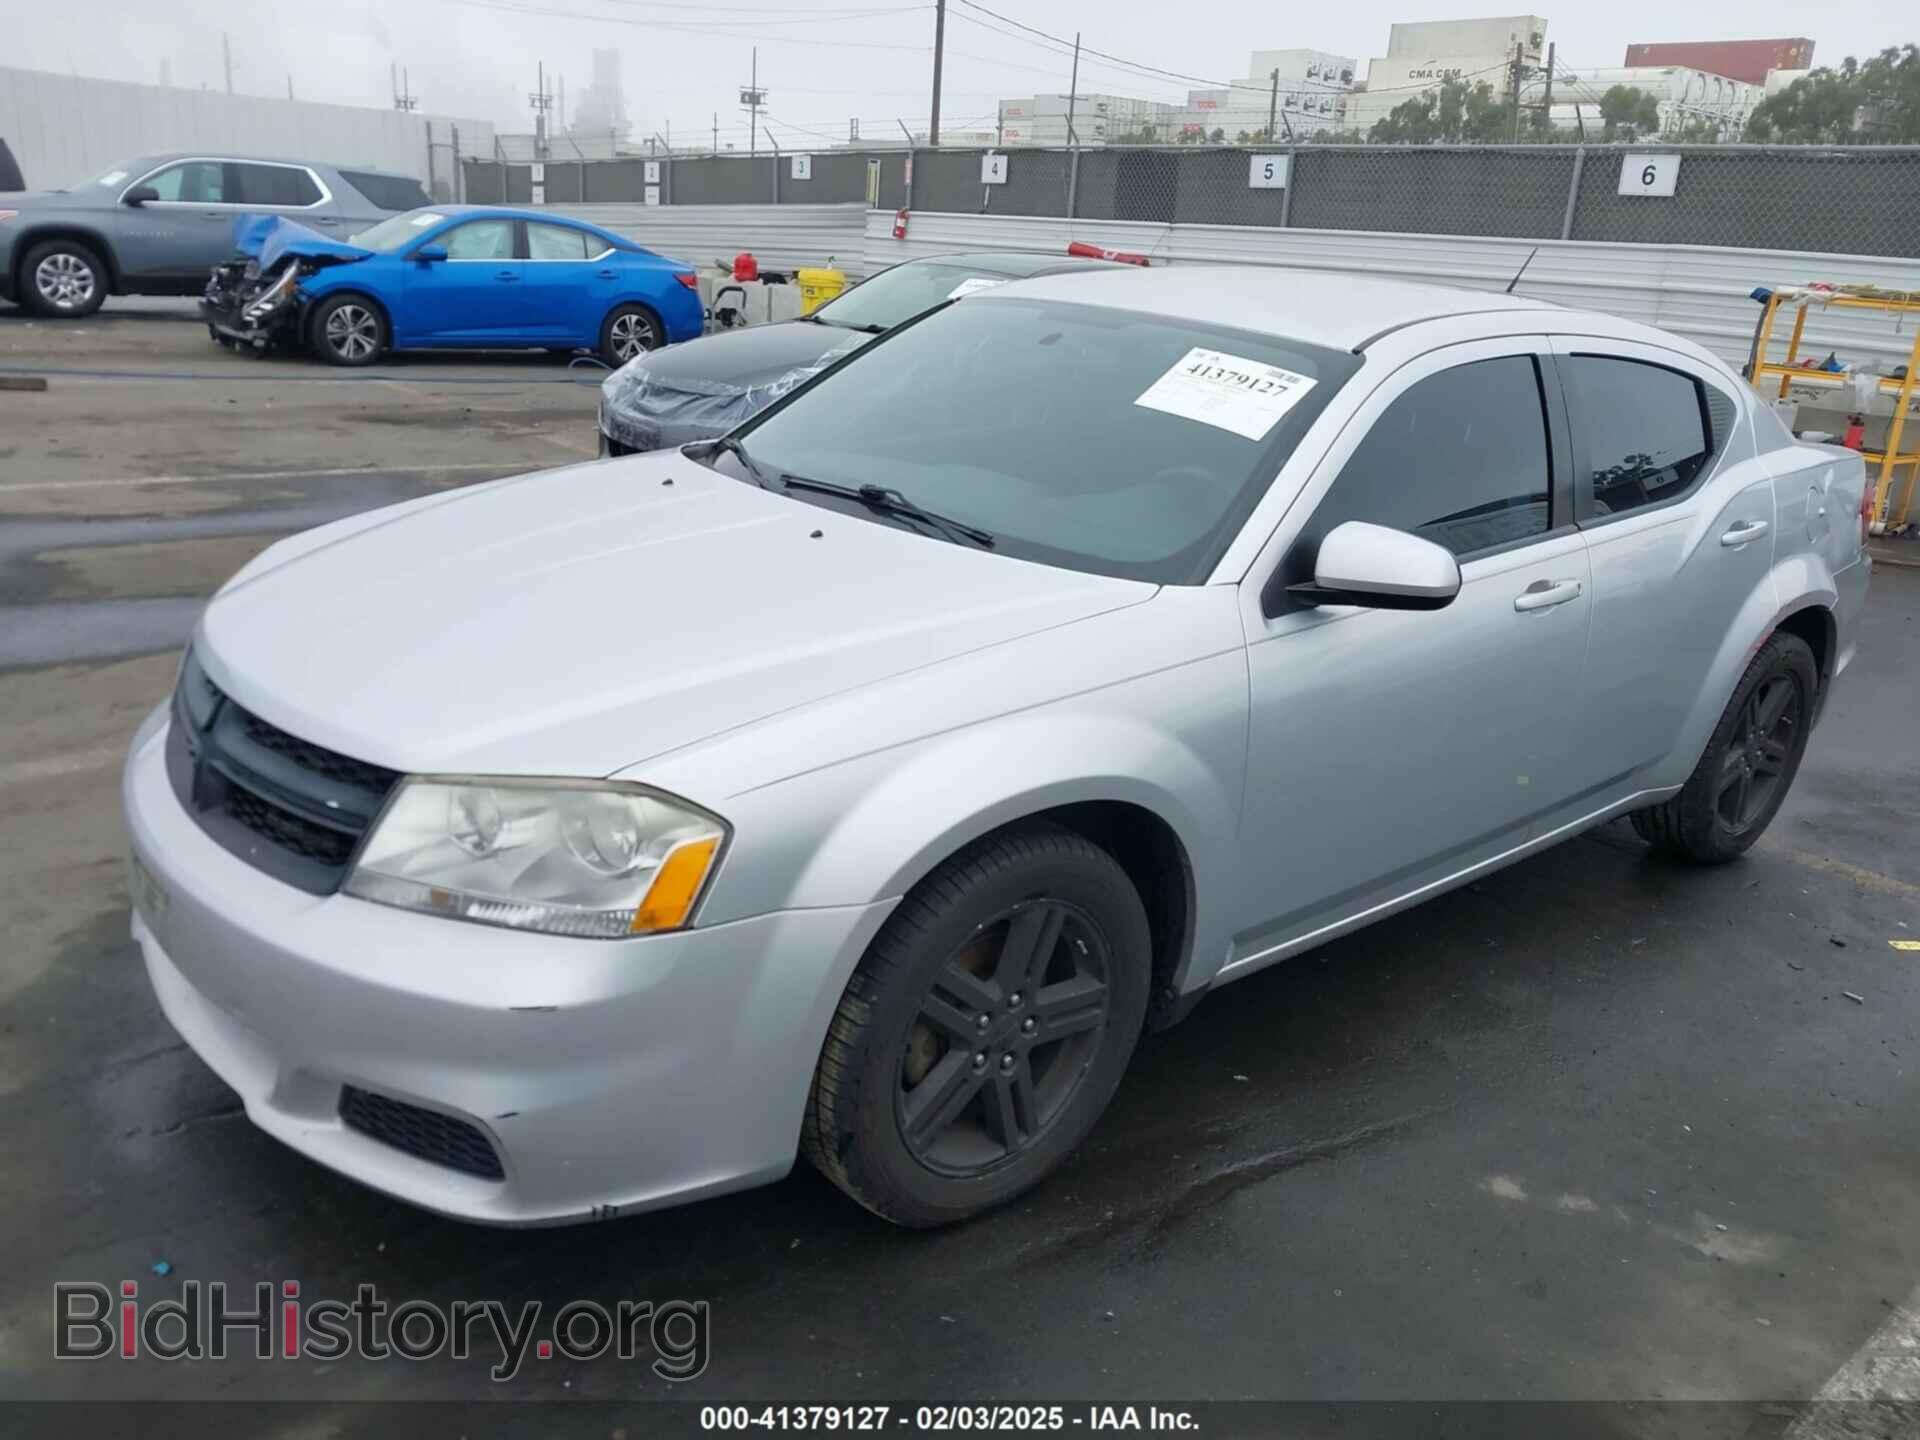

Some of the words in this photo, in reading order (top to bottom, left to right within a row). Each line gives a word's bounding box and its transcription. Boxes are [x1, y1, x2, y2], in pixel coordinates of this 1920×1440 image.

[1408, 70, 1433, 79] CMA
[799, 160, 805, 174] 3
[991, 161, 999, 176] 4
[1264, 163, 1274, 180] 5
[1641, 165, 1656, 186] 6
[1187, 363, 1289, 397] 41379127
